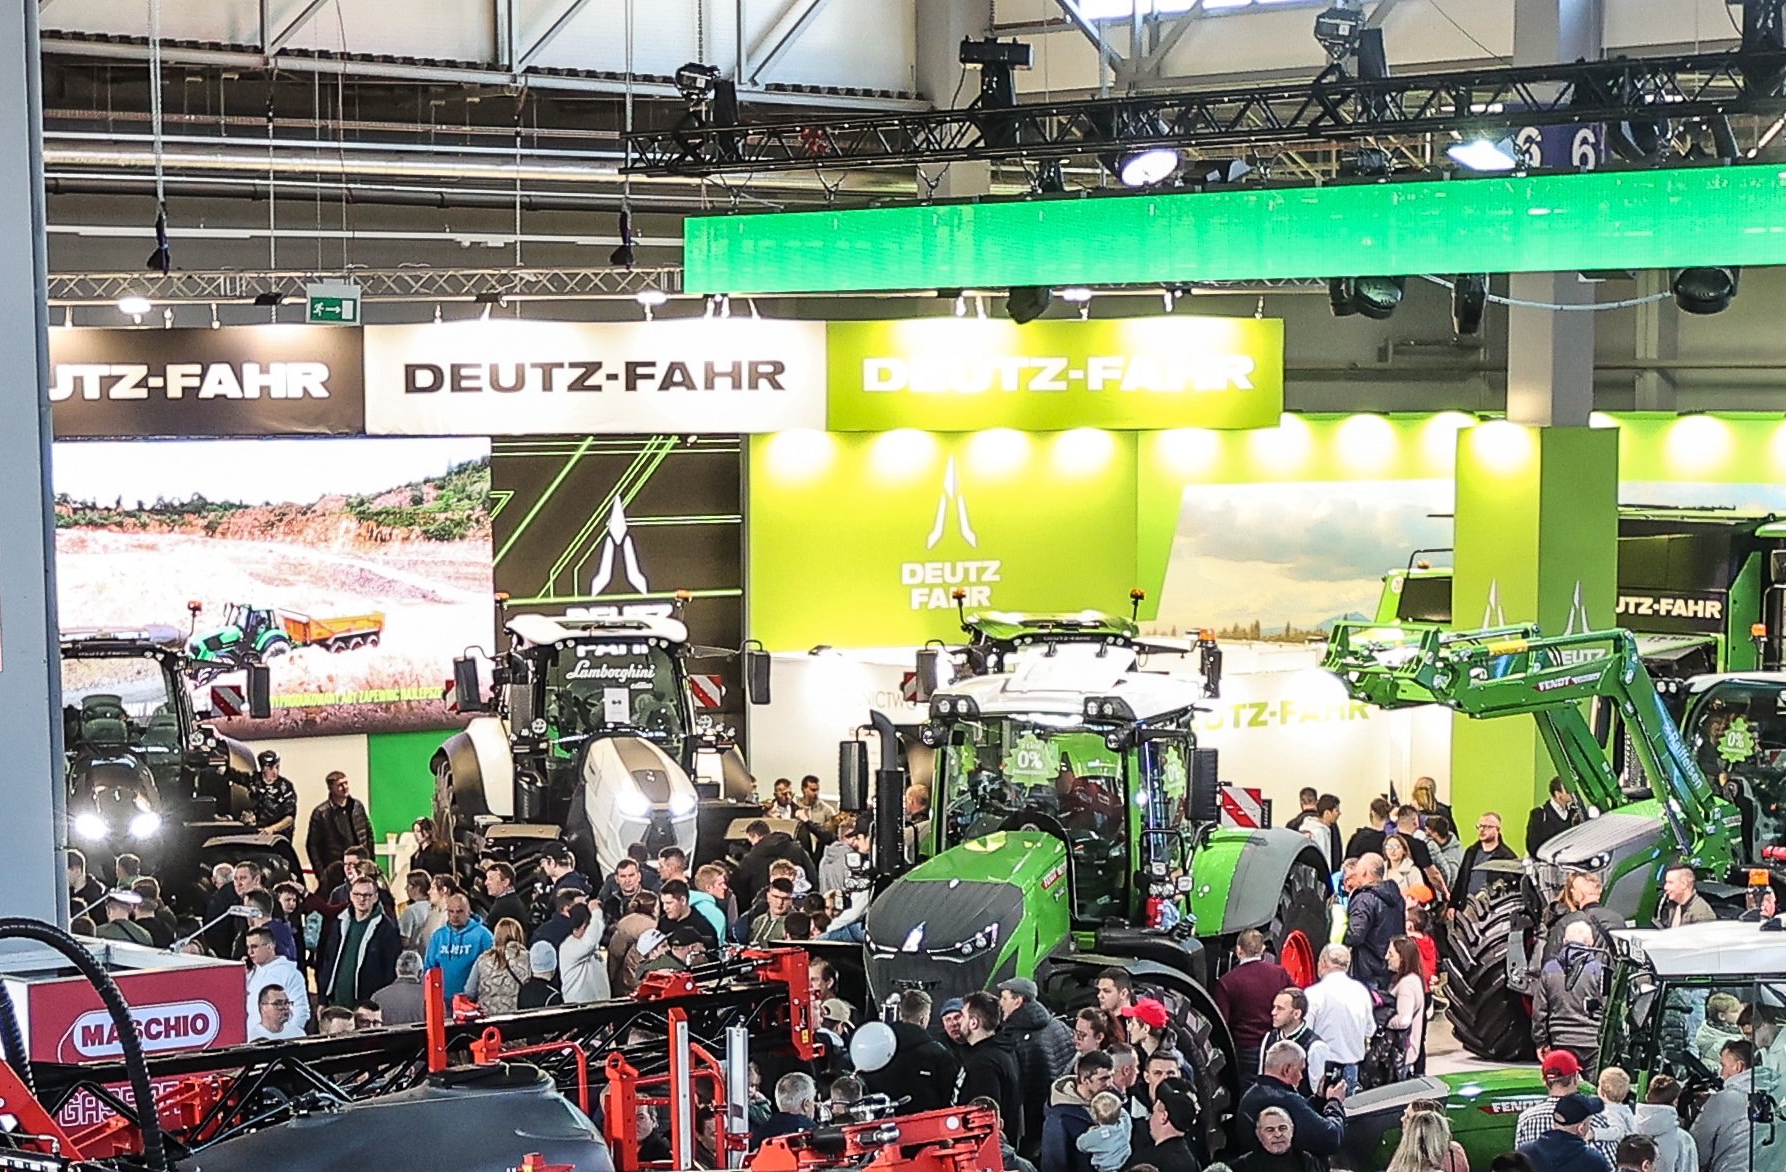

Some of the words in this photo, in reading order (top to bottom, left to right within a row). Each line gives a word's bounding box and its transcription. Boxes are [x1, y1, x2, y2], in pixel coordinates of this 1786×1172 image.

[404, 360, 786, 394] DEUTZ-FAHR
[862, 354, 1256, 392] DEUTZ-FAHR
[901, 559, 1001, 585] DEUTZ
[566, 660, 655, 682] Lamborghini
[1017, 751, 1044, 769] 0%
